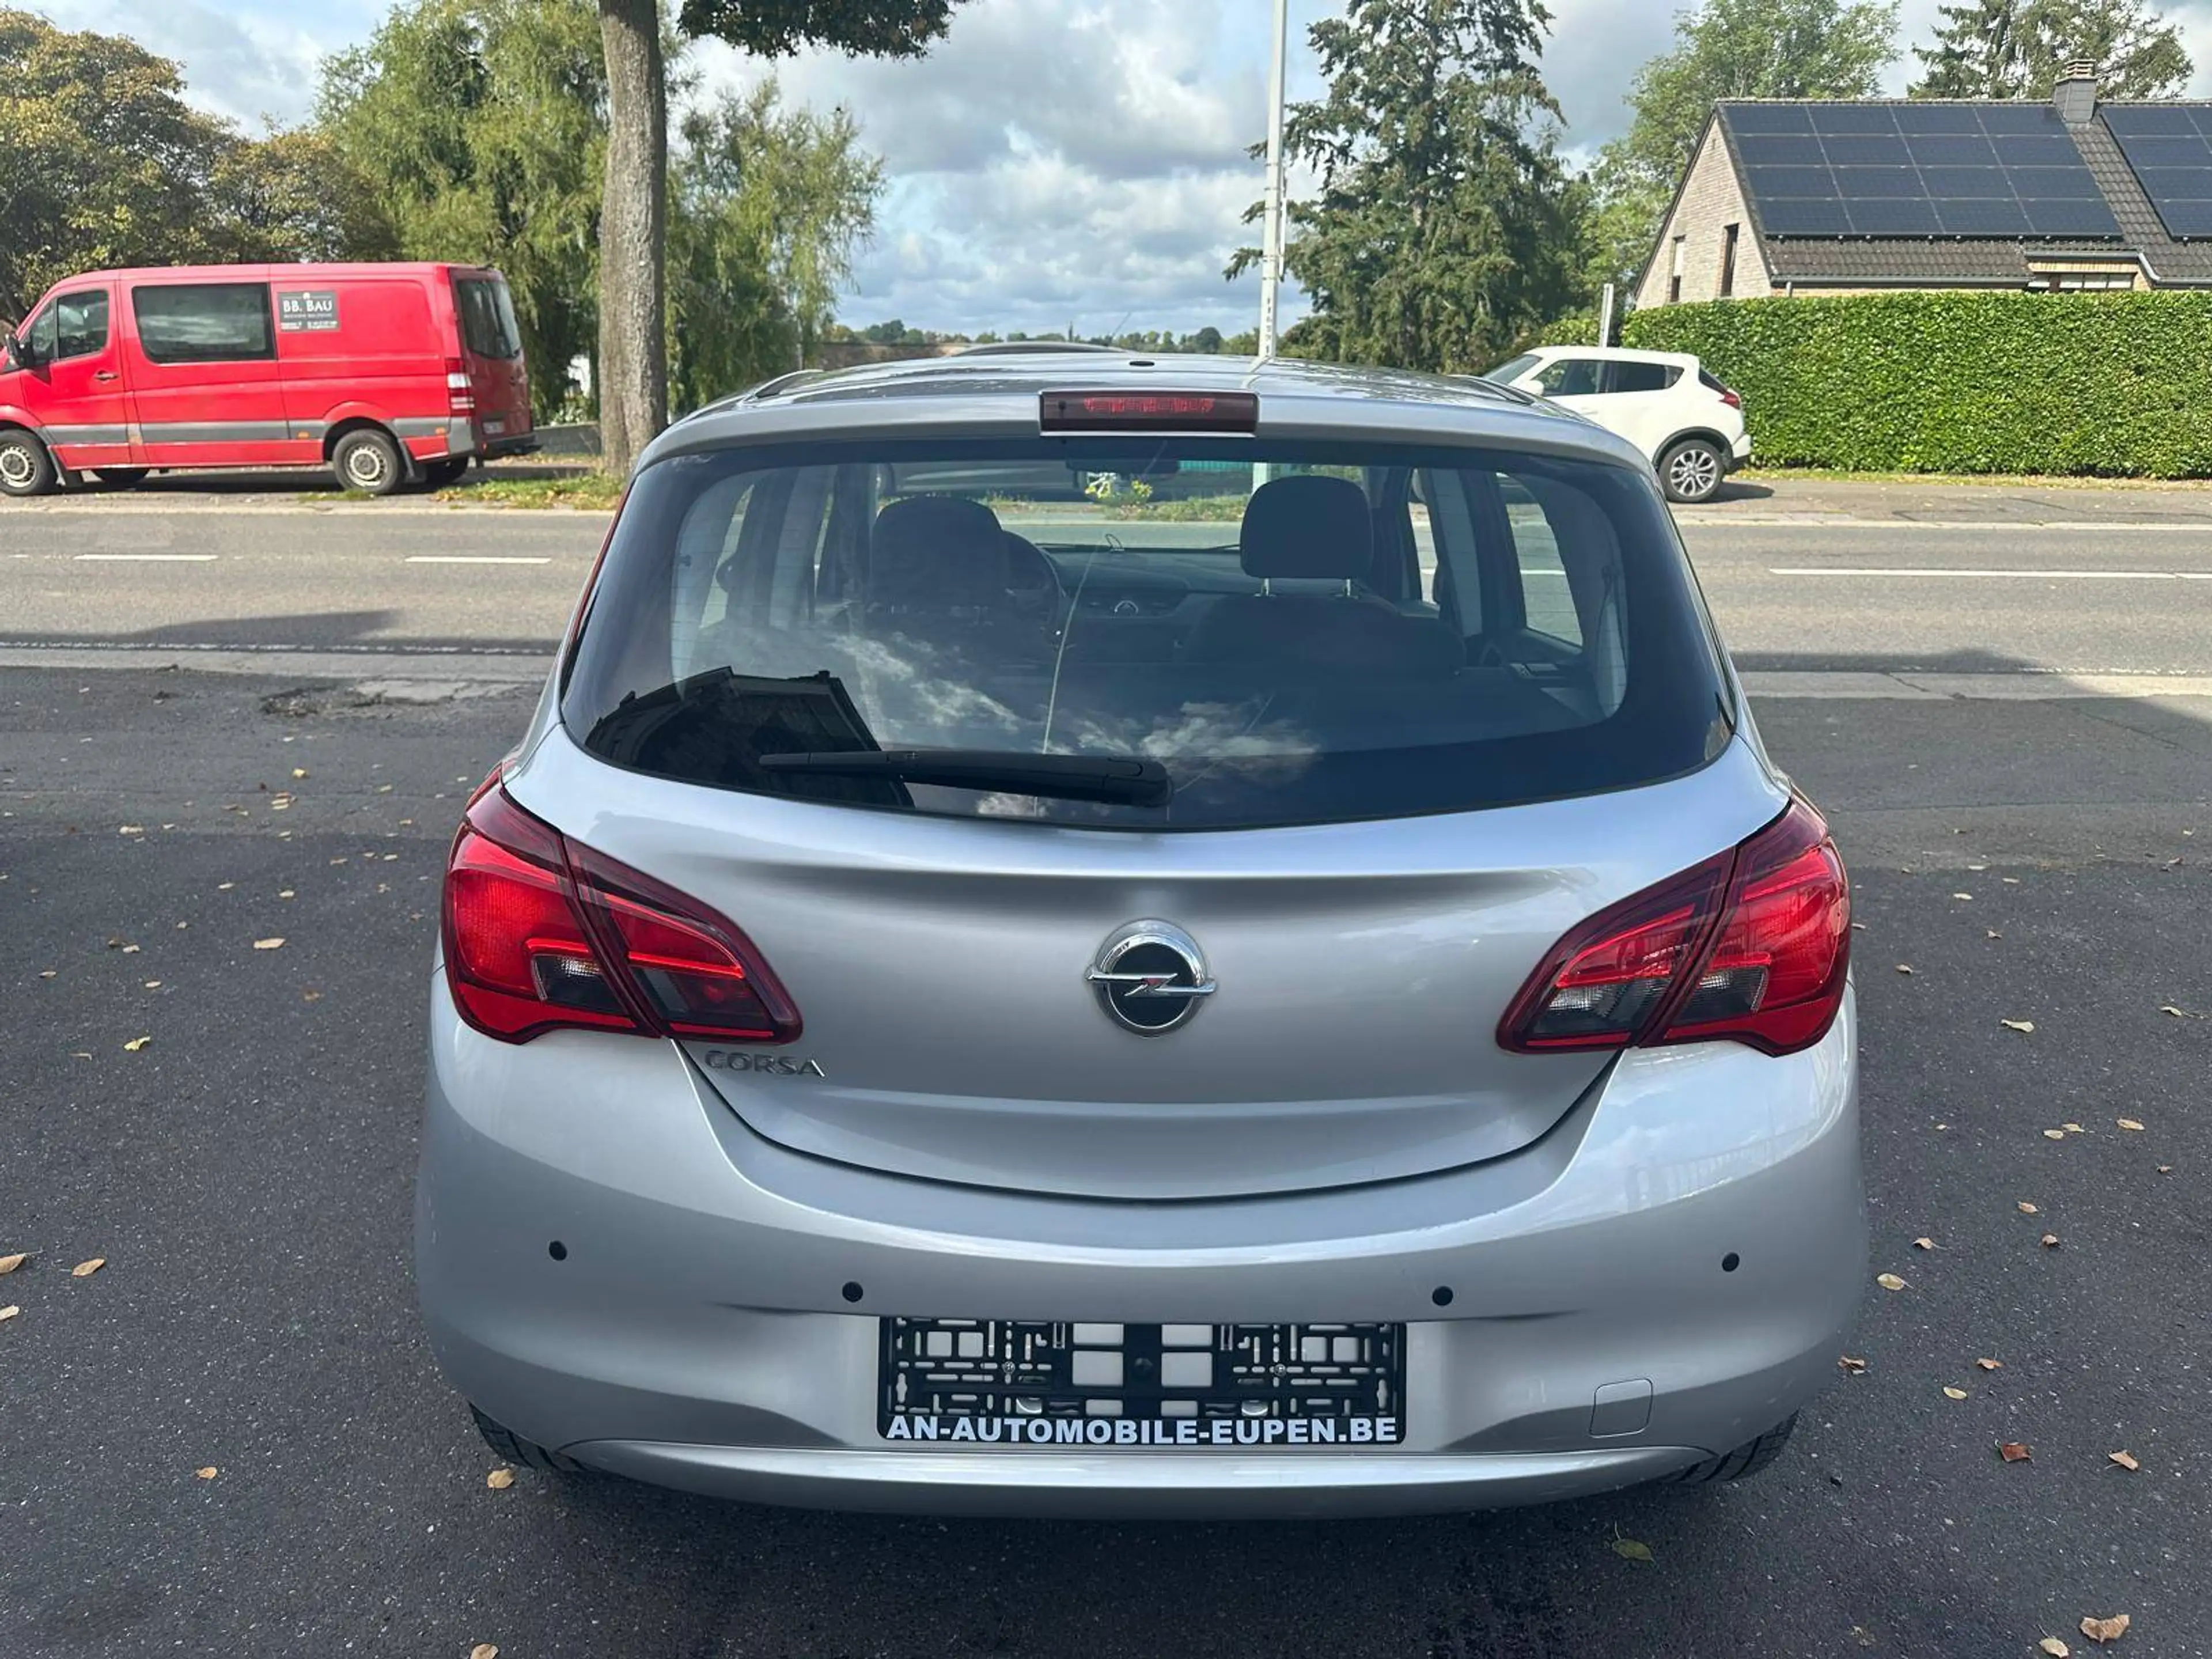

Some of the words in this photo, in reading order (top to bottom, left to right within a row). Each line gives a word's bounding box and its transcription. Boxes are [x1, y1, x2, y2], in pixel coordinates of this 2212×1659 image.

[306, 300, 332, 312] BAU
[704, 1050, 825, 1077] CORSA
[886, 1415, 1397, 1444] AN-AUTOMOBILE-EUPEN.BE
